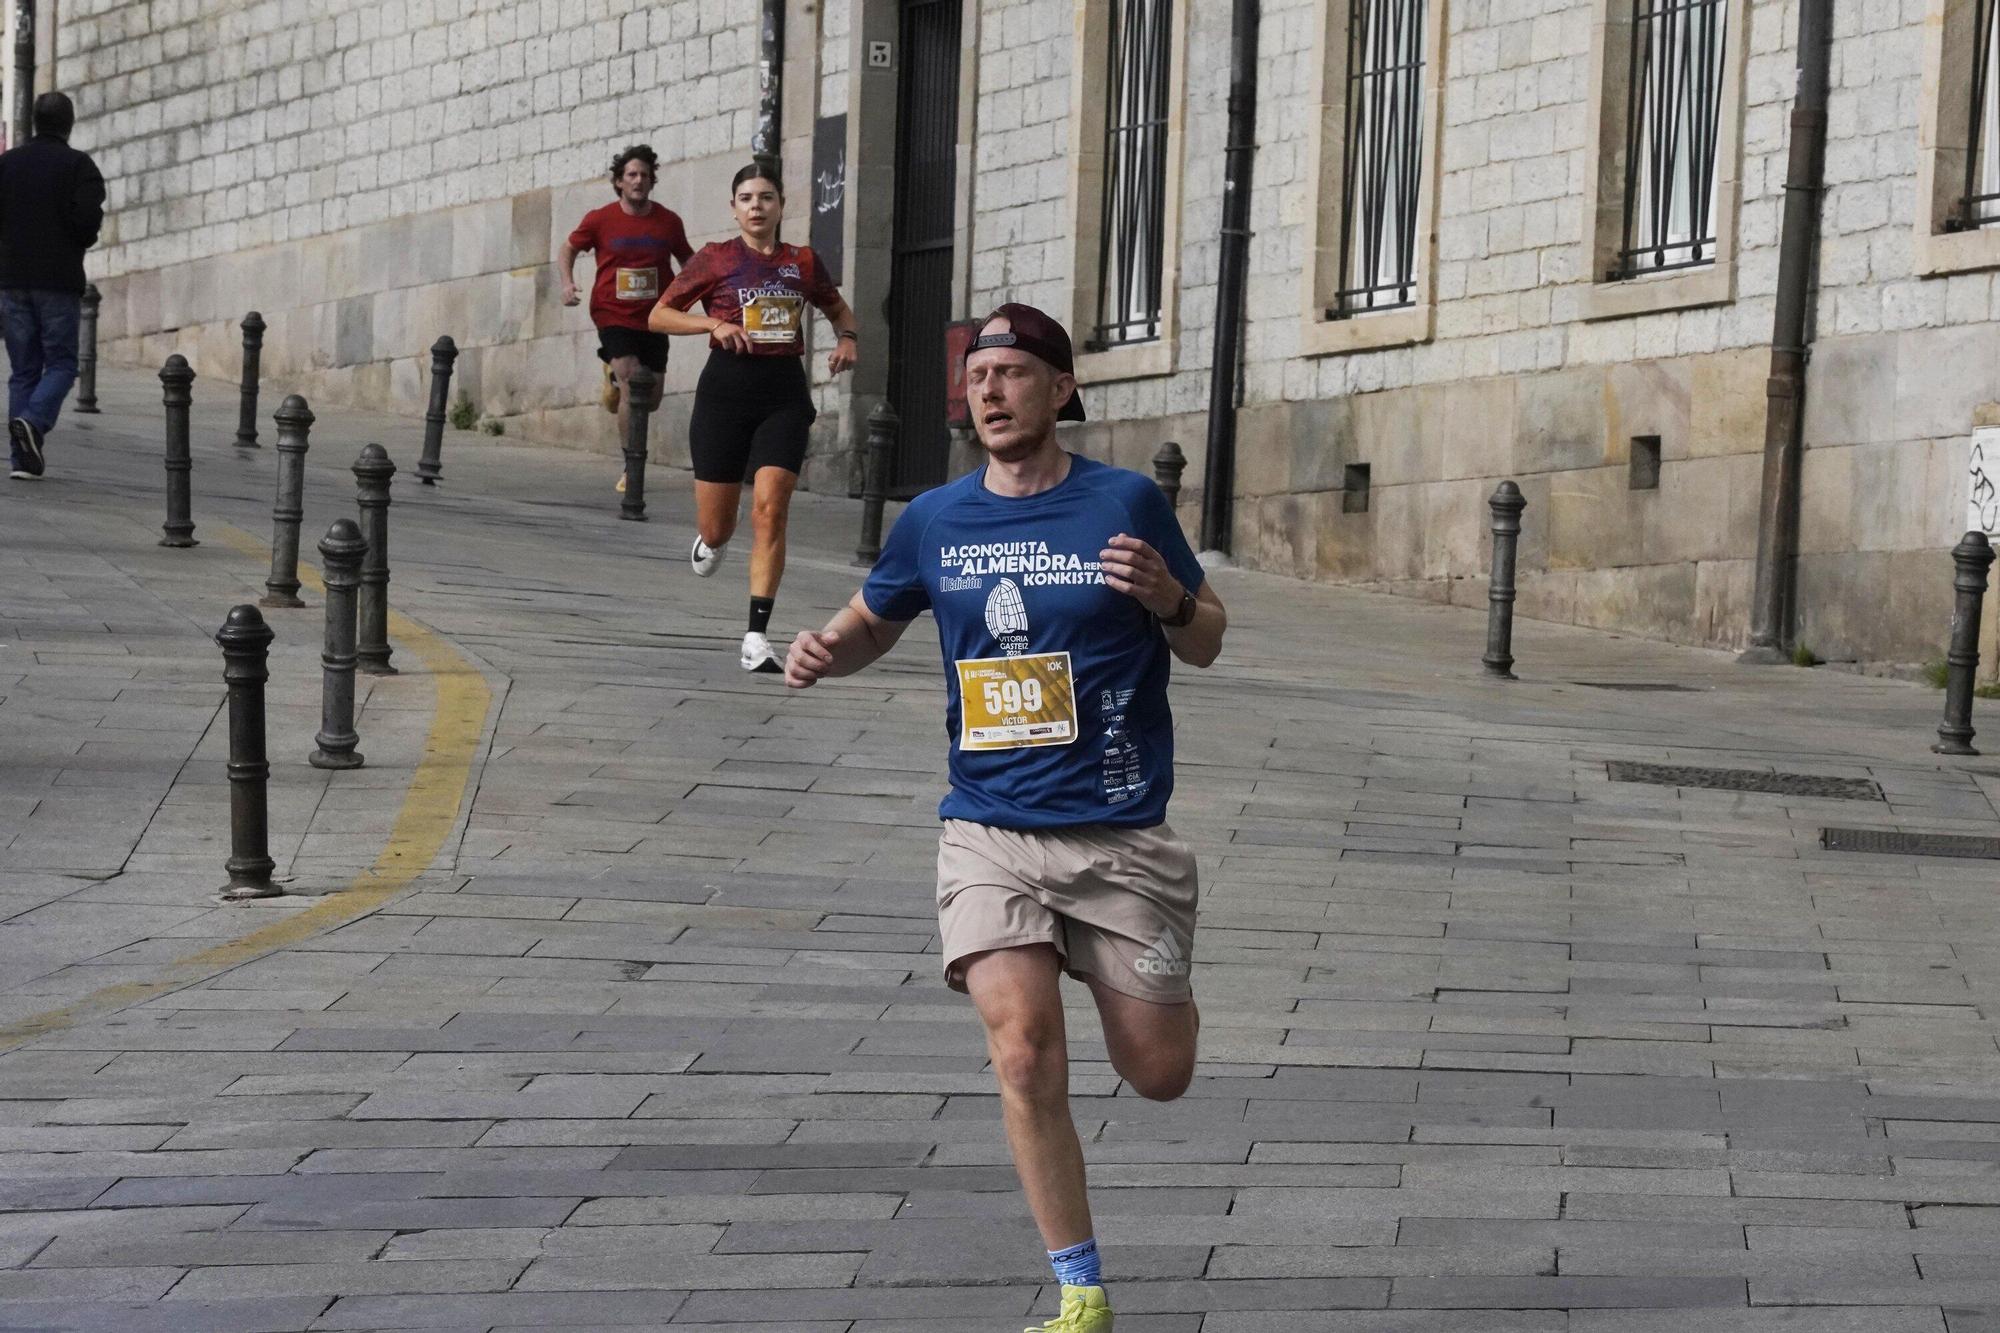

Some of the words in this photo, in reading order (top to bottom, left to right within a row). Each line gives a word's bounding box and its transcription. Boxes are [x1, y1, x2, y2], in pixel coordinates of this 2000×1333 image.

[941, 547, 955, 559] LA
[959, 541, 1049, 559] CONQUISTA
[941, 559, 952, 568] DE
[953, 558, 963, 566] LA
[961, 554, 1083, 576] ALMENDRA
[1023, 571, 1107, 587] KONKISTA
[999, 635, 1029, 643] VITORIA
[1047, 661, 1063, 672] 10K
[983, 678, 1043, 715] 599
[1134, 957, 1188, 976] adidas
